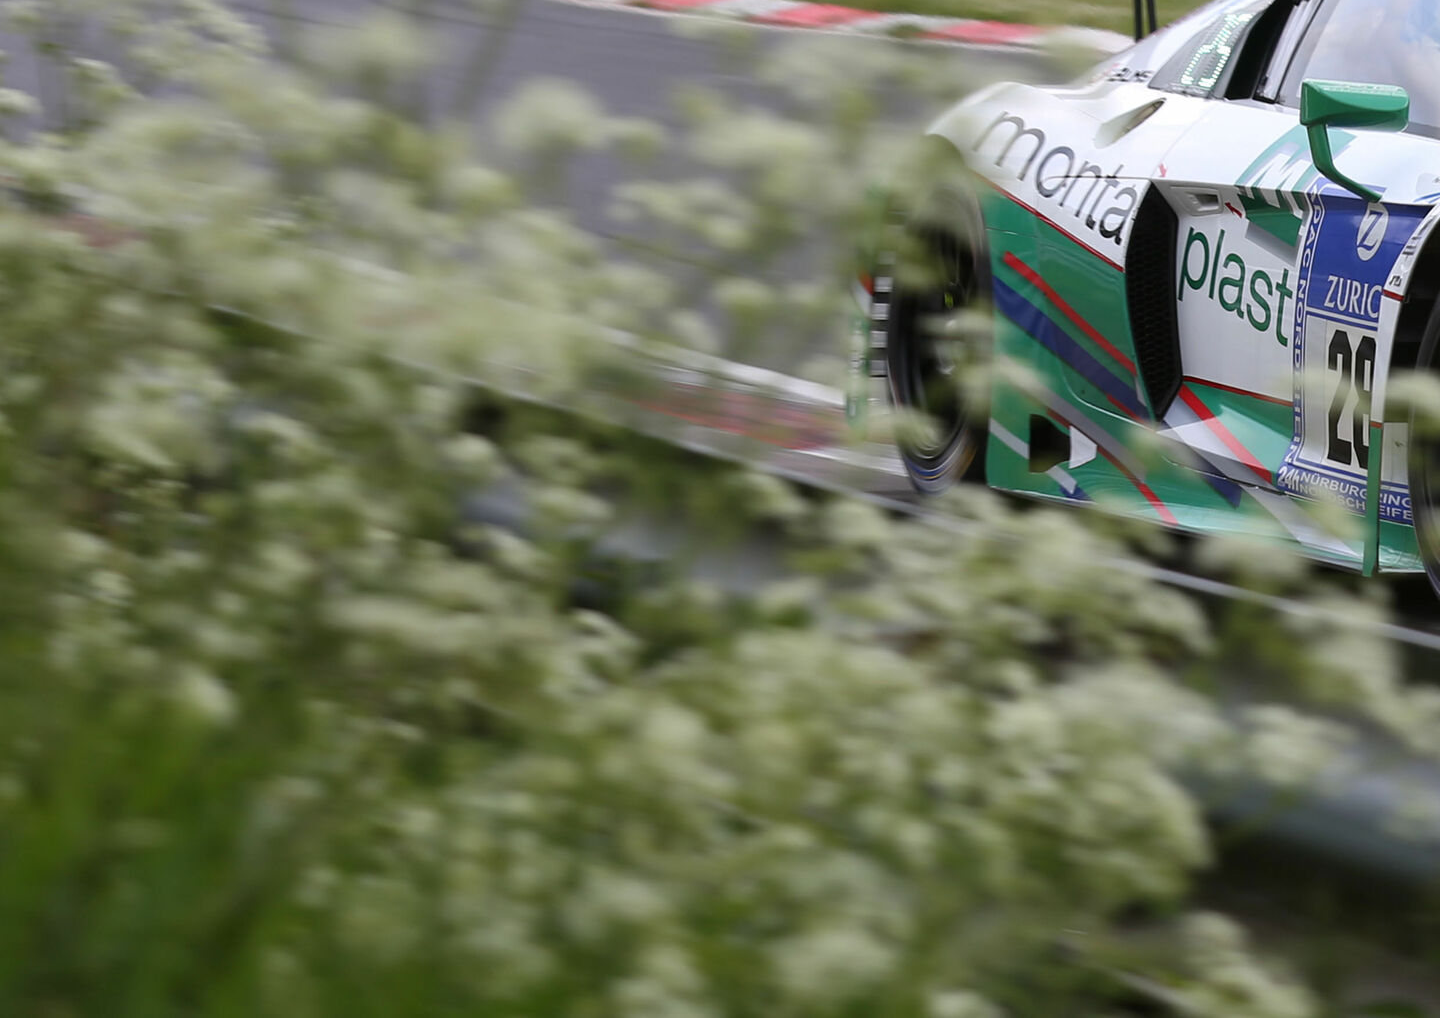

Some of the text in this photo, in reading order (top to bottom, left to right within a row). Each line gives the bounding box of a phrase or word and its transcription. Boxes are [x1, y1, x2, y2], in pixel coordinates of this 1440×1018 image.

[972, 111, 1138, 246] monta
[1302, 183, 1322, 267] ADAC
[1178, 226, 1294, 348] plast
[1327, 329, 1376, 470] 28
[1277, 466, 1300, 493] 24h
[1300, 471, 1413, 510] NÜRBURGING
